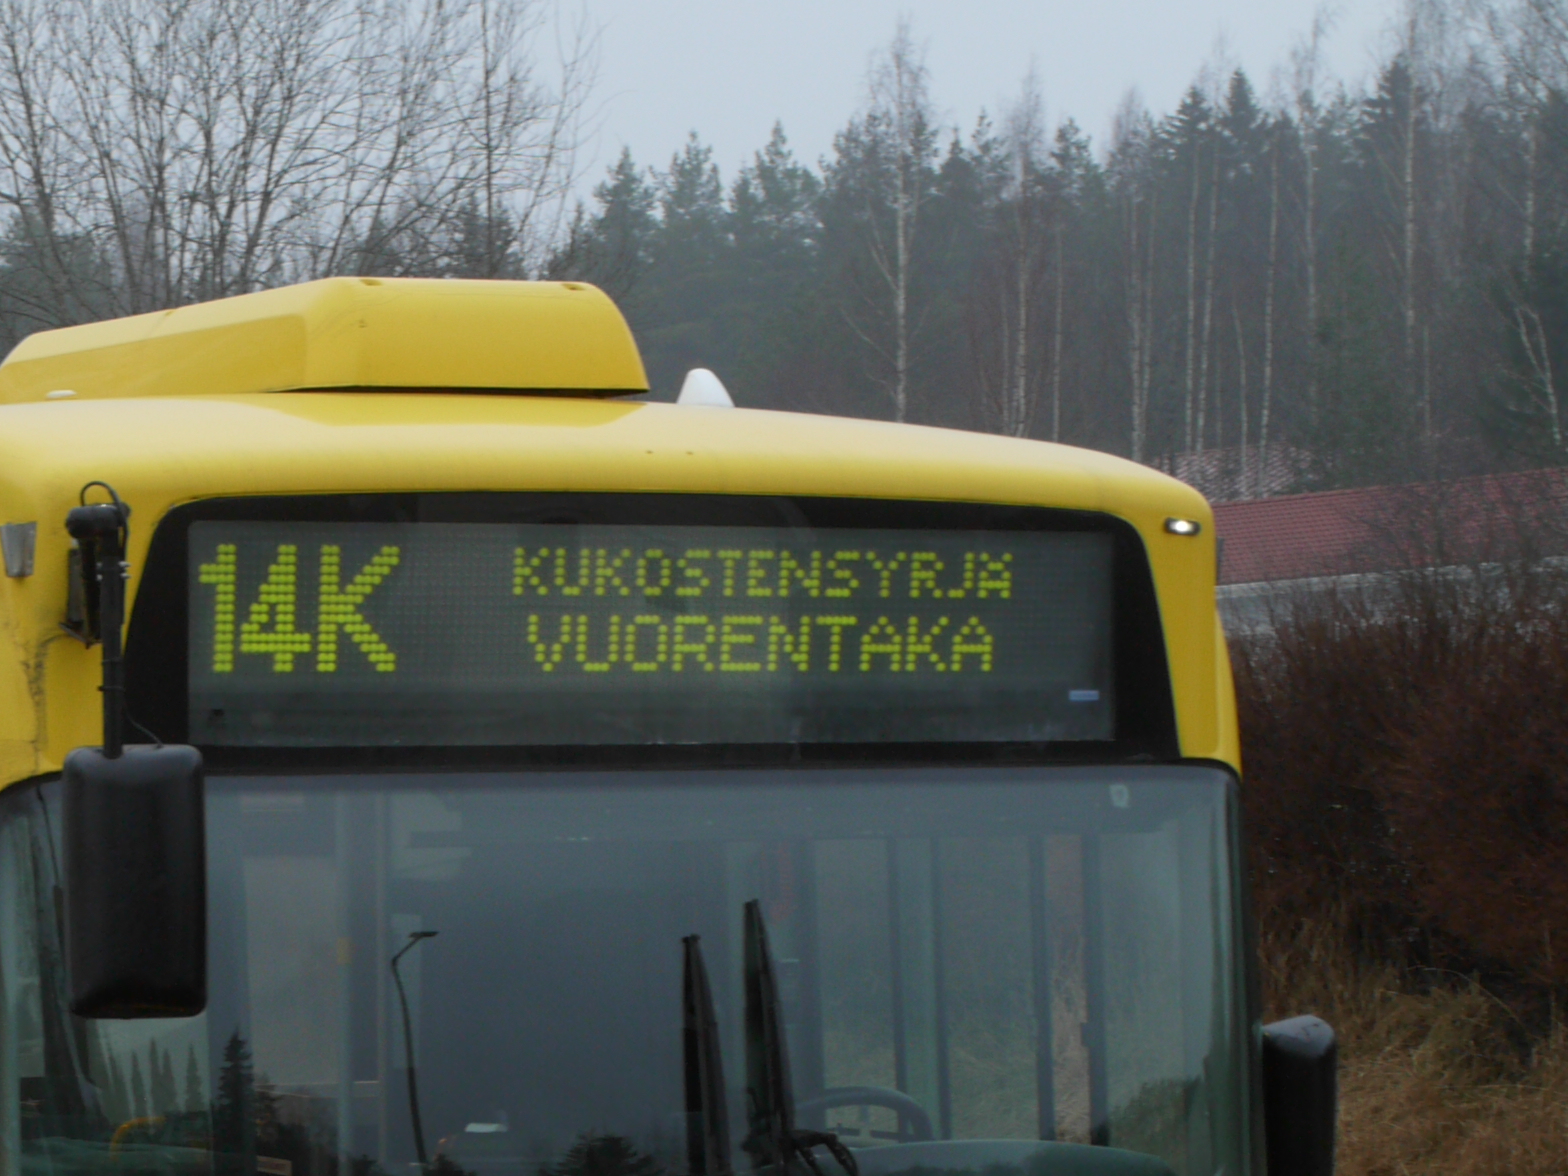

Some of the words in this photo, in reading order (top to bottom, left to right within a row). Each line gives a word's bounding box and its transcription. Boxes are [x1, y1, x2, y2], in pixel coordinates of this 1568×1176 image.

[199, 543, 401, 673] 14K
[512, 546, 1014, 600] KUKOSTENSYRJÄ
[526, 614, 993, 673] VUORENTAKA
